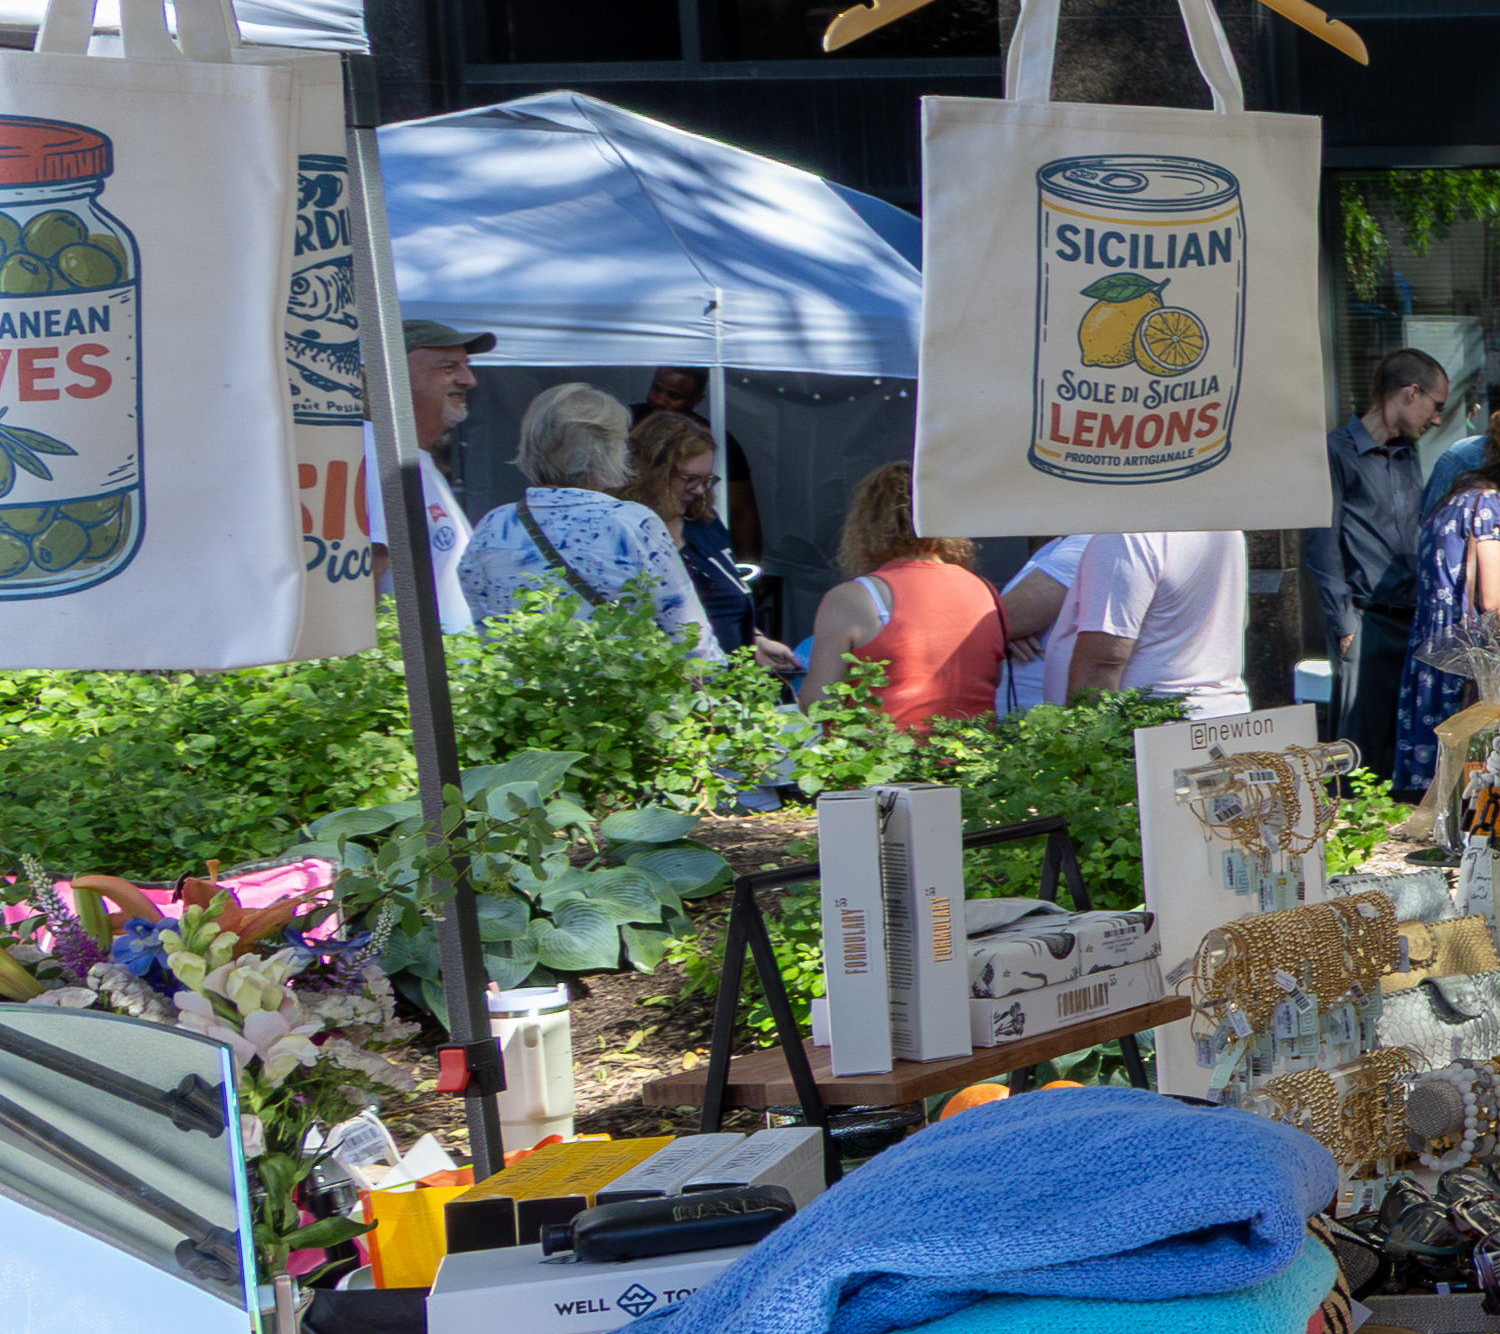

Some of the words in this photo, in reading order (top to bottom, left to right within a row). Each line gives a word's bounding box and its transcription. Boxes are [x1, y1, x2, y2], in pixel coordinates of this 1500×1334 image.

[1055, 224, 1232, 269] SICILIAN
[0, 305, 110, 339] ANEAN
[1050, 402, 1221, 449] LEMONS
[1064, 451, 1121, 467] PRODOTTO
[1123, 448, 1195, 466] ARTIGIANALE
[841, 909, 868, 975] FORMULARY
[931, 898, 953, 962] FORMULARY
[555, 1298, 611, 1316] WELL
[663, 1287, 697, 1305] TO
